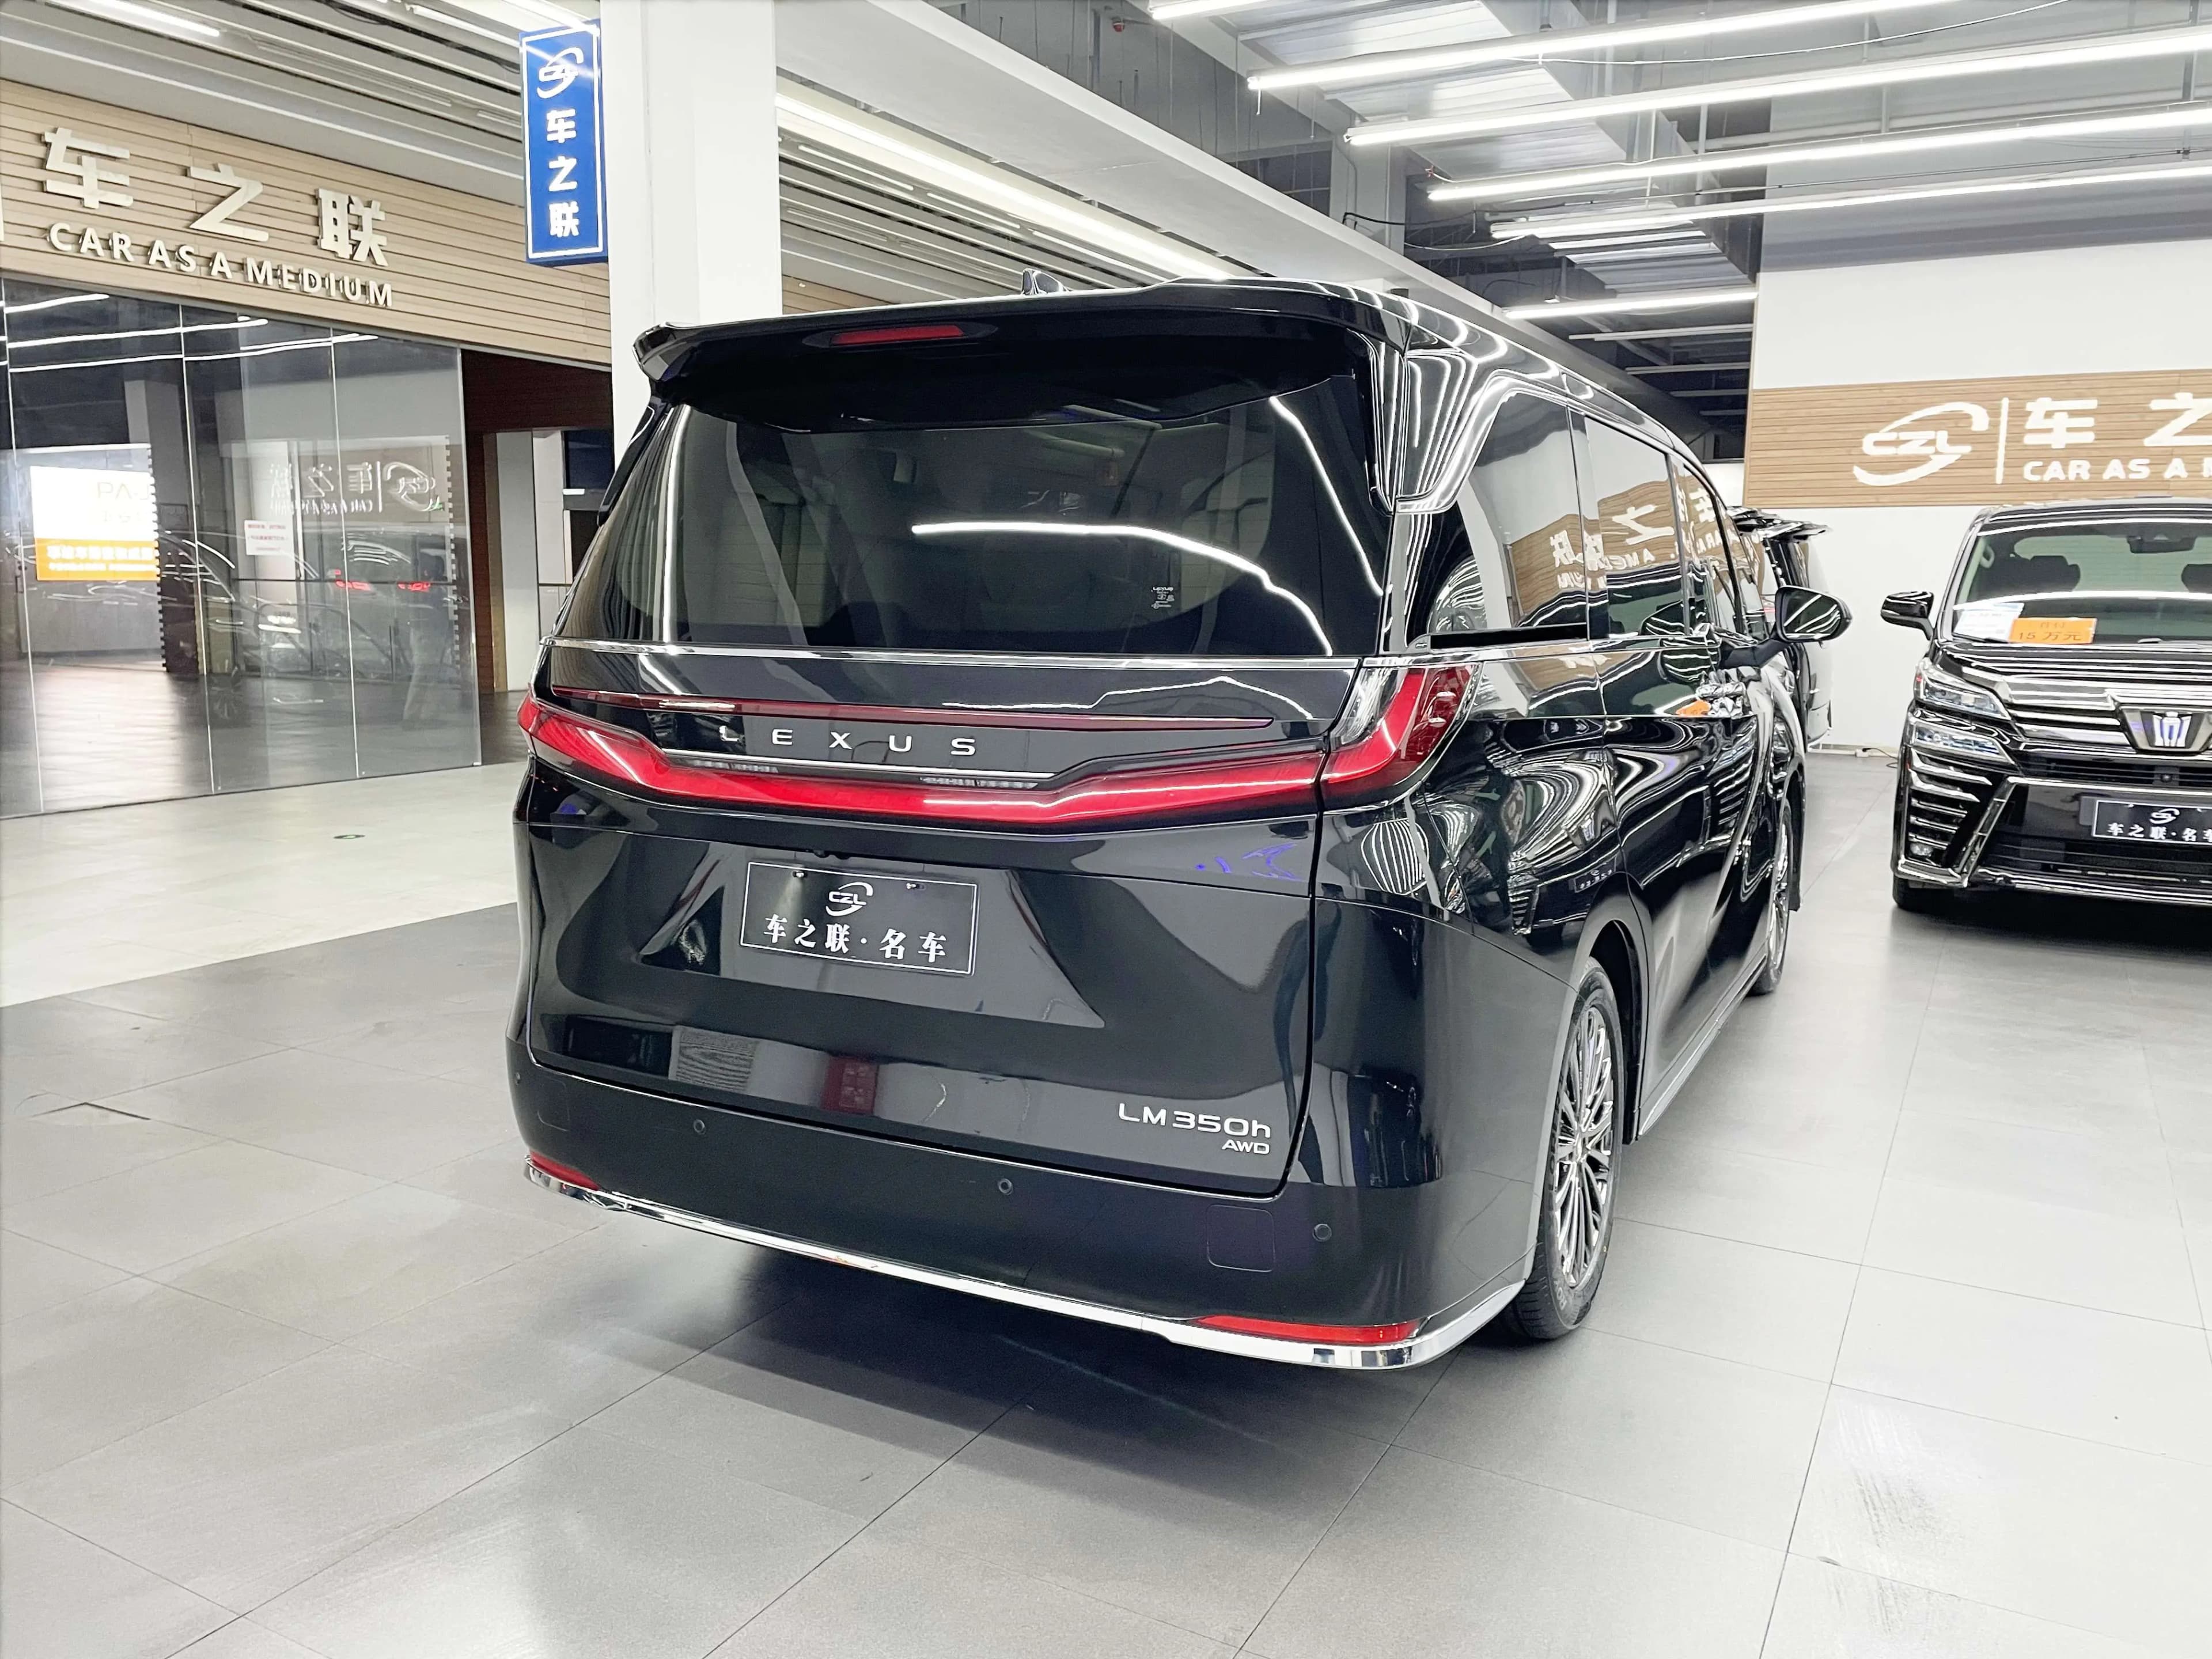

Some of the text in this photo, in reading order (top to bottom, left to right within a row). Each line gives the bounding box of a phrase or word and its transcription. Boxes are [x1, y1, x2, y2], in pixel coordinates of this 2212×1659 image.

[41, 127, 389, 267] 车之联
[546, 108, 579, 238] 车之联
[47, 222, 393, 308] CAR AS A MEDIUM
[2023, 460, 2091, 481] CAR
[2102, 458, 2150, 480] AS
[2164, 458, 2188, 478] A
[719, 725, 976, 756] LEXUS
[1221, 1138, 1270, 1155] AWD
